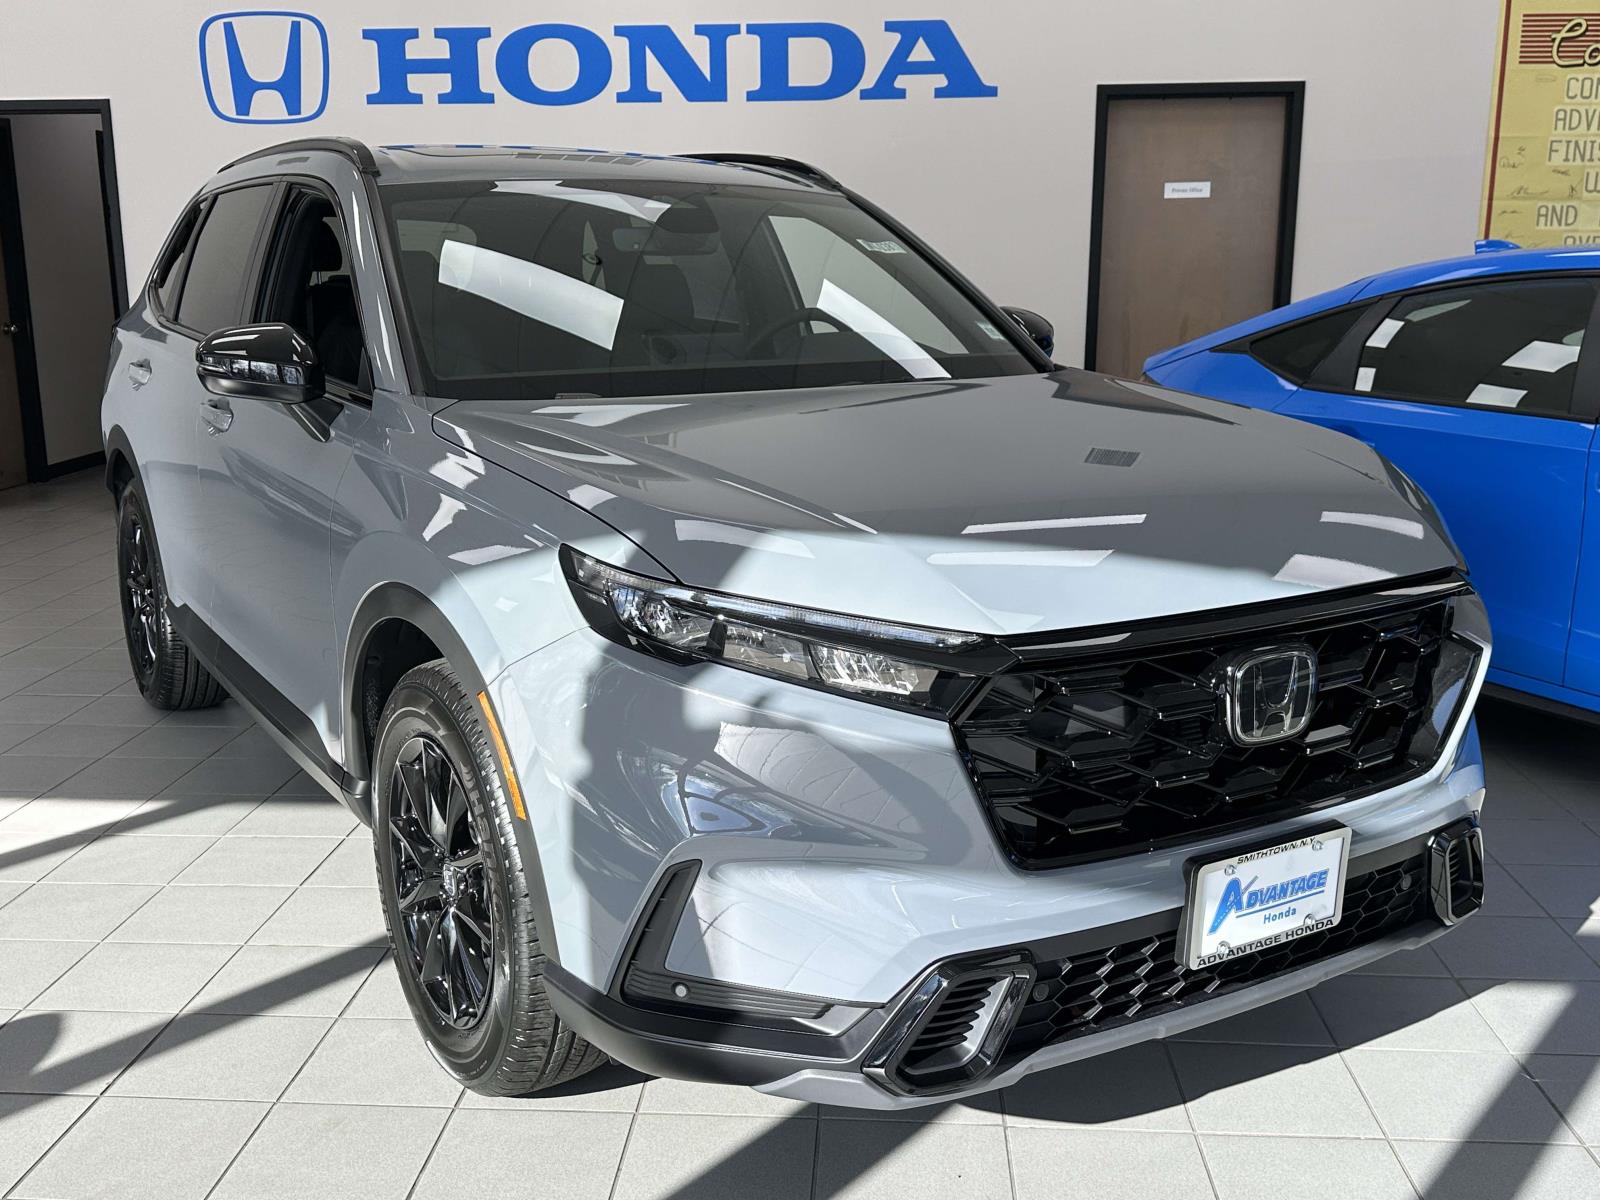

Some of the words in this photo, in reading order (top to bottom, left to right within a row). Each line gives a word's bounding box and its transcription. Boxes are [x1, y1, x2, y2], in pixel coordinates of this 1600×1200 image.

[362, 19, 998, 106] HONDA
[1554, 108, 1600, 131] ADV
[1547, 139, 1600, 163] FINI
[1536, 204, 1578, 227] AND
[1263, 906, 1297, 924] Honda
[1197, 934, 1282, 968] ADVANTAGE
[1285, 918, 1334, 940] HONDA
